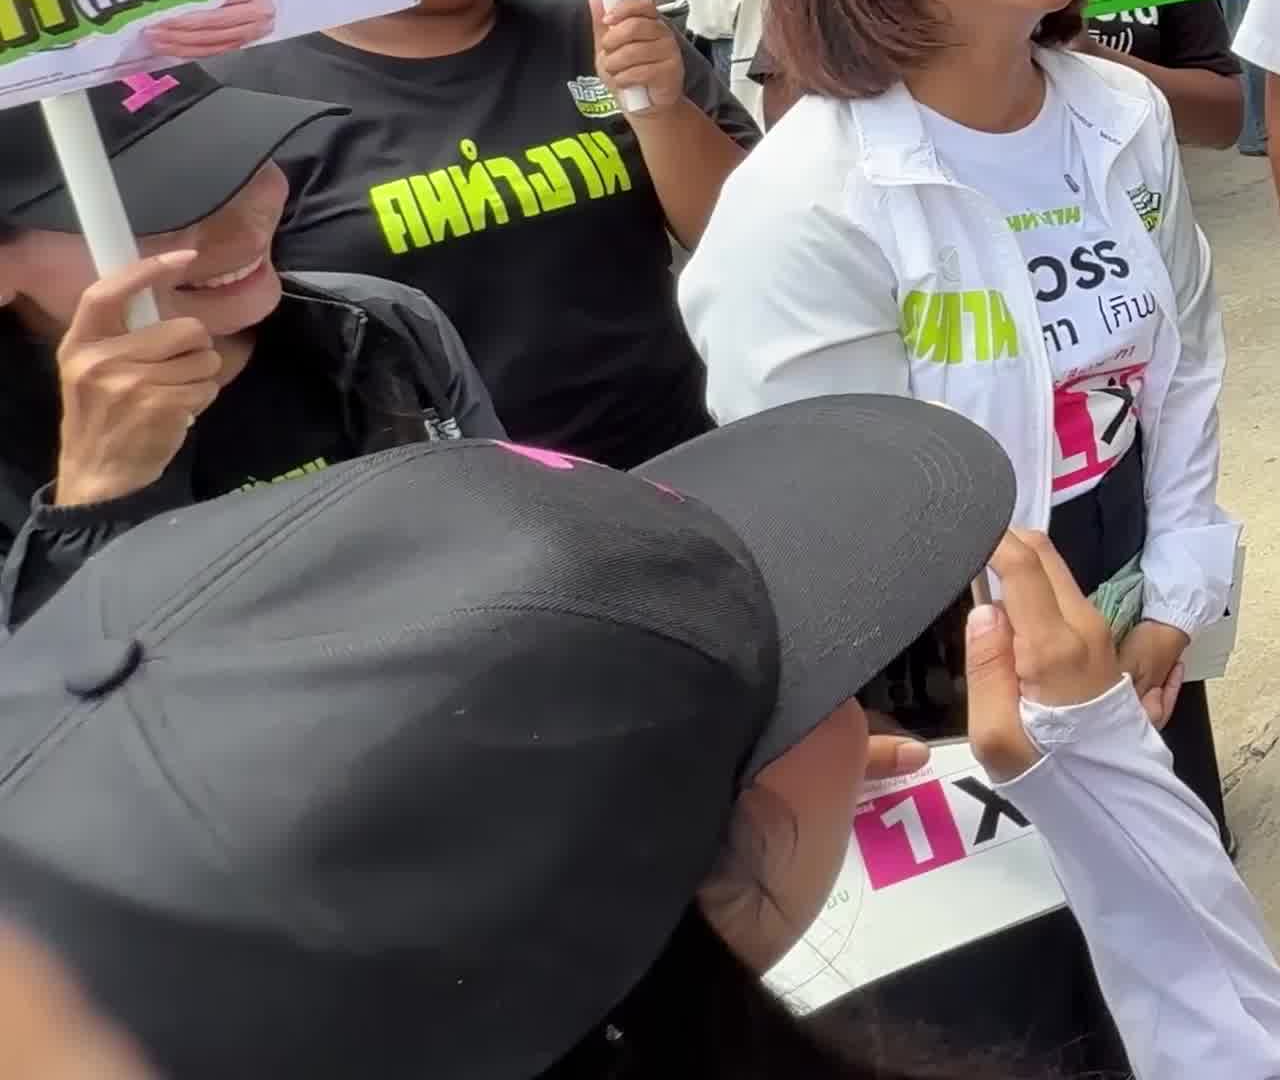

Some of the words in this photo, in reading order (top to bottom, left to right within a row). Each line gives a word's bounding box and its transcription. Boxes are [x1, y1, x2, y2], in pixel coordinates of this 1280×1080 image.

[369, 129, 633, 255] คนทำงาน
[1098, 290, 1157, 336] (กิฟ
[880, 795, 935, 865] 1
